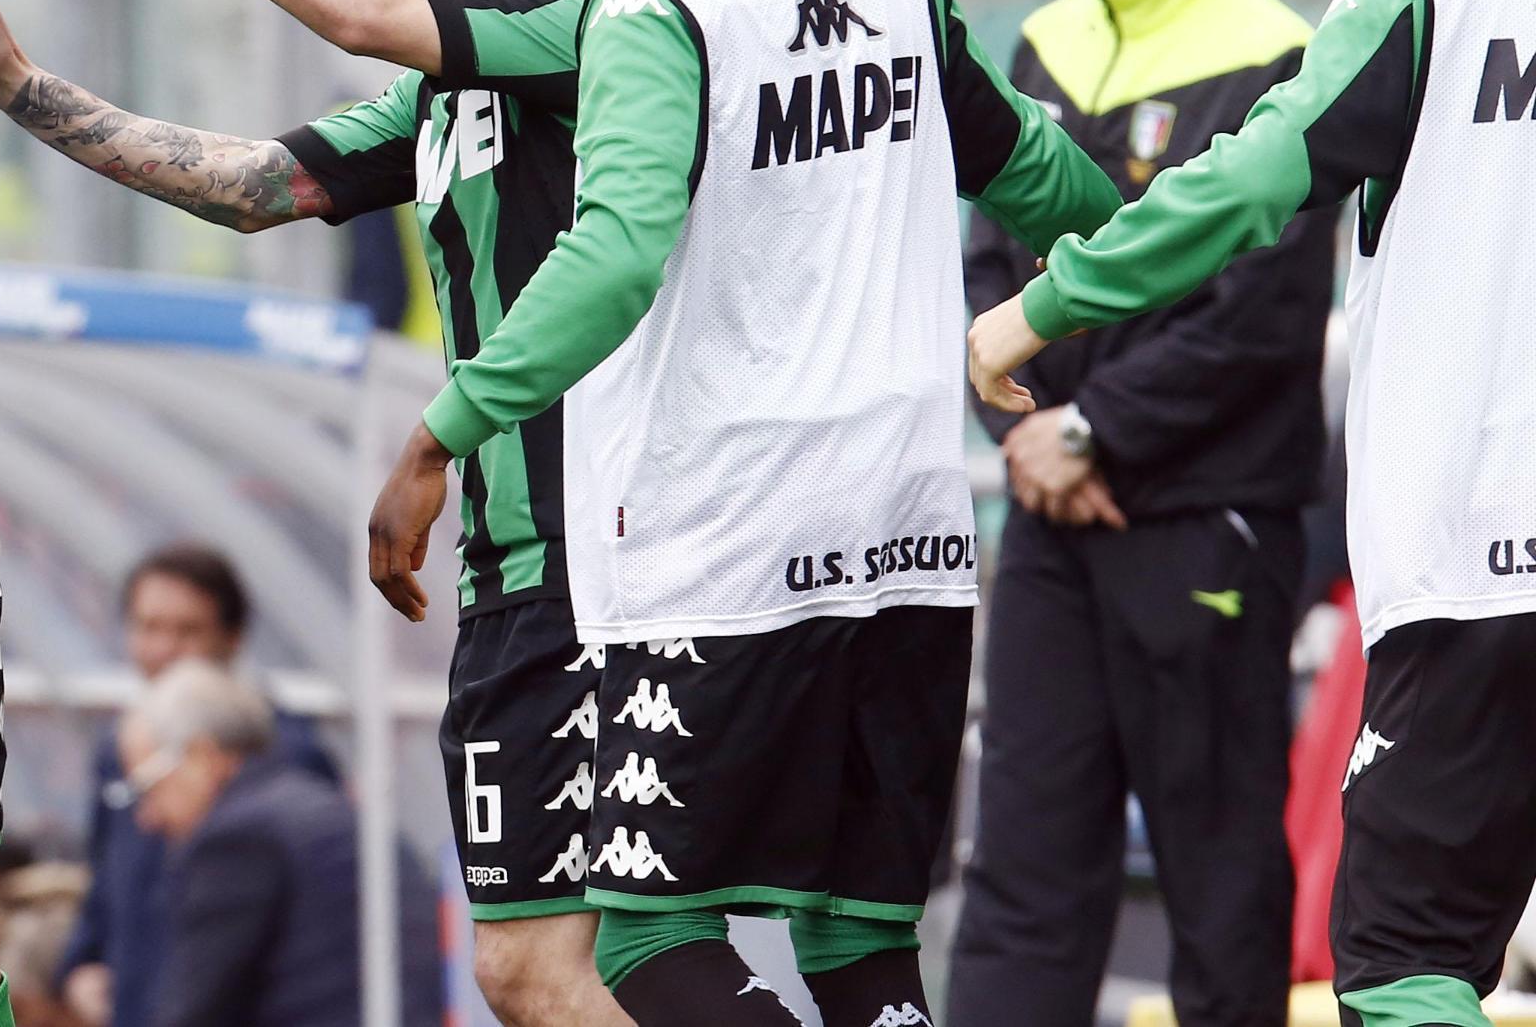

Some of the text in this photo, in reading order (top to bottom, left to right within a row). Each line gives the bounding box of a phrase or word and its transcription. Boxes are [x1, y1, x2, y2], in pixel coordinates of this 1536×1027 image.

[751, 56, 922, 171] MAPEI
[787, 552, 853, 591] U.S.
[463, 740, 502, 844] 6
